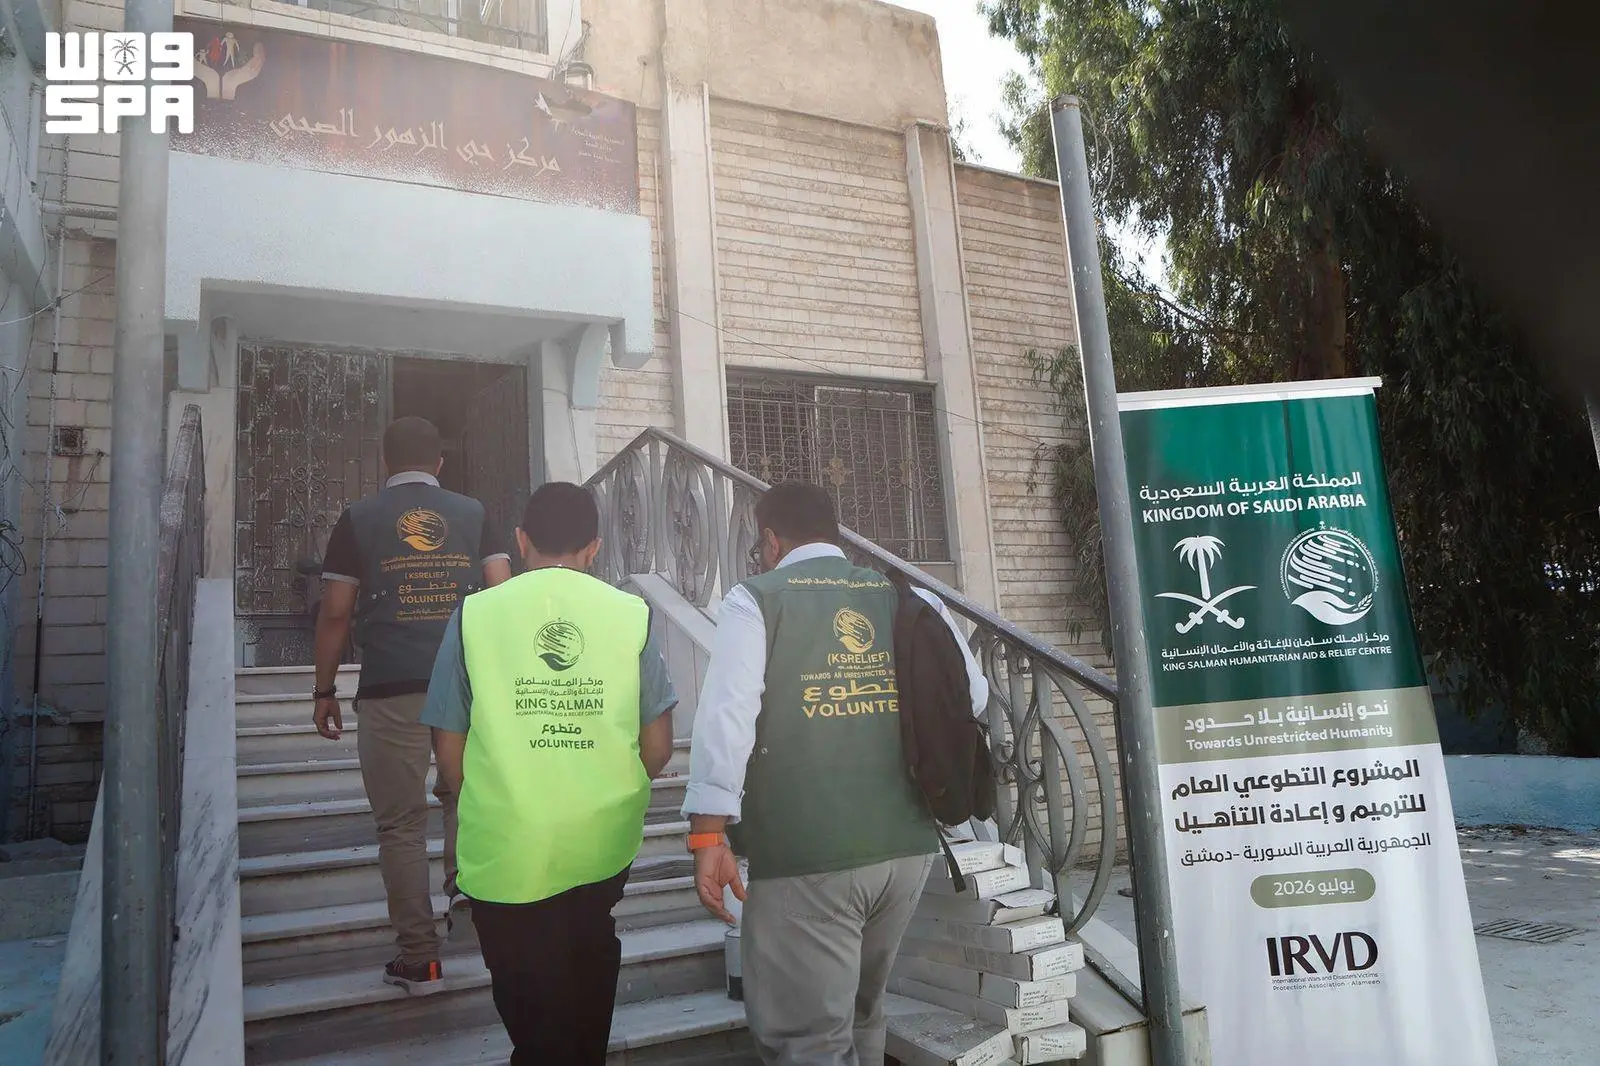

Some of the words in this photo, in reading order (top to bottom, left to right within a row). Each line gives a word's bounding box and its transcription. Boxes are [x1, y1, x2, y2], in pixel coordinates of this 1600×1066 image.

[269, 107, 360, 141] الصحي
[366, 120, 449, 156] الزهور
[456, 139, 496, 166] حي
[502, 136, 561, 177] مركز
[1229, 476, 1289, 497] العربية
[1292, 471, 1362, 489] المملكة
[1139, 481, 1226, 504] السعودية
[1142, 503, 1224, 523] KINGDOM
[1227, 502, 1250, 515] OF
[1254, 498, 1303, 513] SAUDI
[1307, 493, 1367, 510] ARABIA
[398, 581, 457, 594] متطوع
[400, 593, 457, 604] VOLUNTEER
[1210, 640, 1255, 654] والأعمال
[1256, 638, 1292, 651] للإغاثة
[1293, 636, 1333, 648] سلمان
[1334, 634, 1363, 645] الملك
[1365, 632, 1390, 644] مركز
[828, 651, 890, 666] (KSRELIEF)
[1161, 643, 1210, 661] الإنسانية
[1162, 661, 1186, 672] KING
[1187, 658, 1228, 670] SALMAN
[1229, 653, 1301, 667] HUMANITARIAN
[1302, 651, 1318, 660] AID
[1319, 650, 1327, 659] &
[1328, 648, 1358, 658] RELIEF
[1358, 645, 1392, 656] CENTRE
[515, 677, 550, 687] سلمان
[551, 677, 578, 687] الملك
[579, 677, 603, 687] مركز
[800, 672, 831, 681] TOWARDS
[803, 678, 898, 702] تطوع
[516, 698, 548, 709] KING
[550, 699, 604, 710] SALMAN
[1356, 700, 1389, 720] نحو
[1184, 713, 1255, 733] حدود
[1258, 707, 1284, 727] بلا
[1286, 703, 1353, 726] إنسانية
[541, 723, 582, 734] متطوع
[1186, 737, 1242, 751] Towards
[1244, 729, 1328, 746] Unrestricted
[1329, 725, 1393, 741] Humanity
[529, 739, 595, 750] VOLUNTEER
[1233, 766, 1327, 799] التطوعي
[1332, 759, 1420, 788] المشروع
[1171, 773, 1229, 801] العام
[1350, 793, 1426, 822] للترميم
[1174, 805, 1266, 835] التأهيل
[1243, 842, 1303, 862] السورية
[1306, 838, 1354, 858] العربية
[1357, 832, 1432, 854] الجمهورية
[1273, 880, 1315, 896] 2026
[1317, 878, 1356, 896] يوليو
[1266, 931, 1379, 977] IRVD
[1272, 976, 1306, 985] International
[1357, 971, 1379, 979] Victims
[1273, 983, 1307, 992] Protection
[1308, 981, 1346, 990] Association
